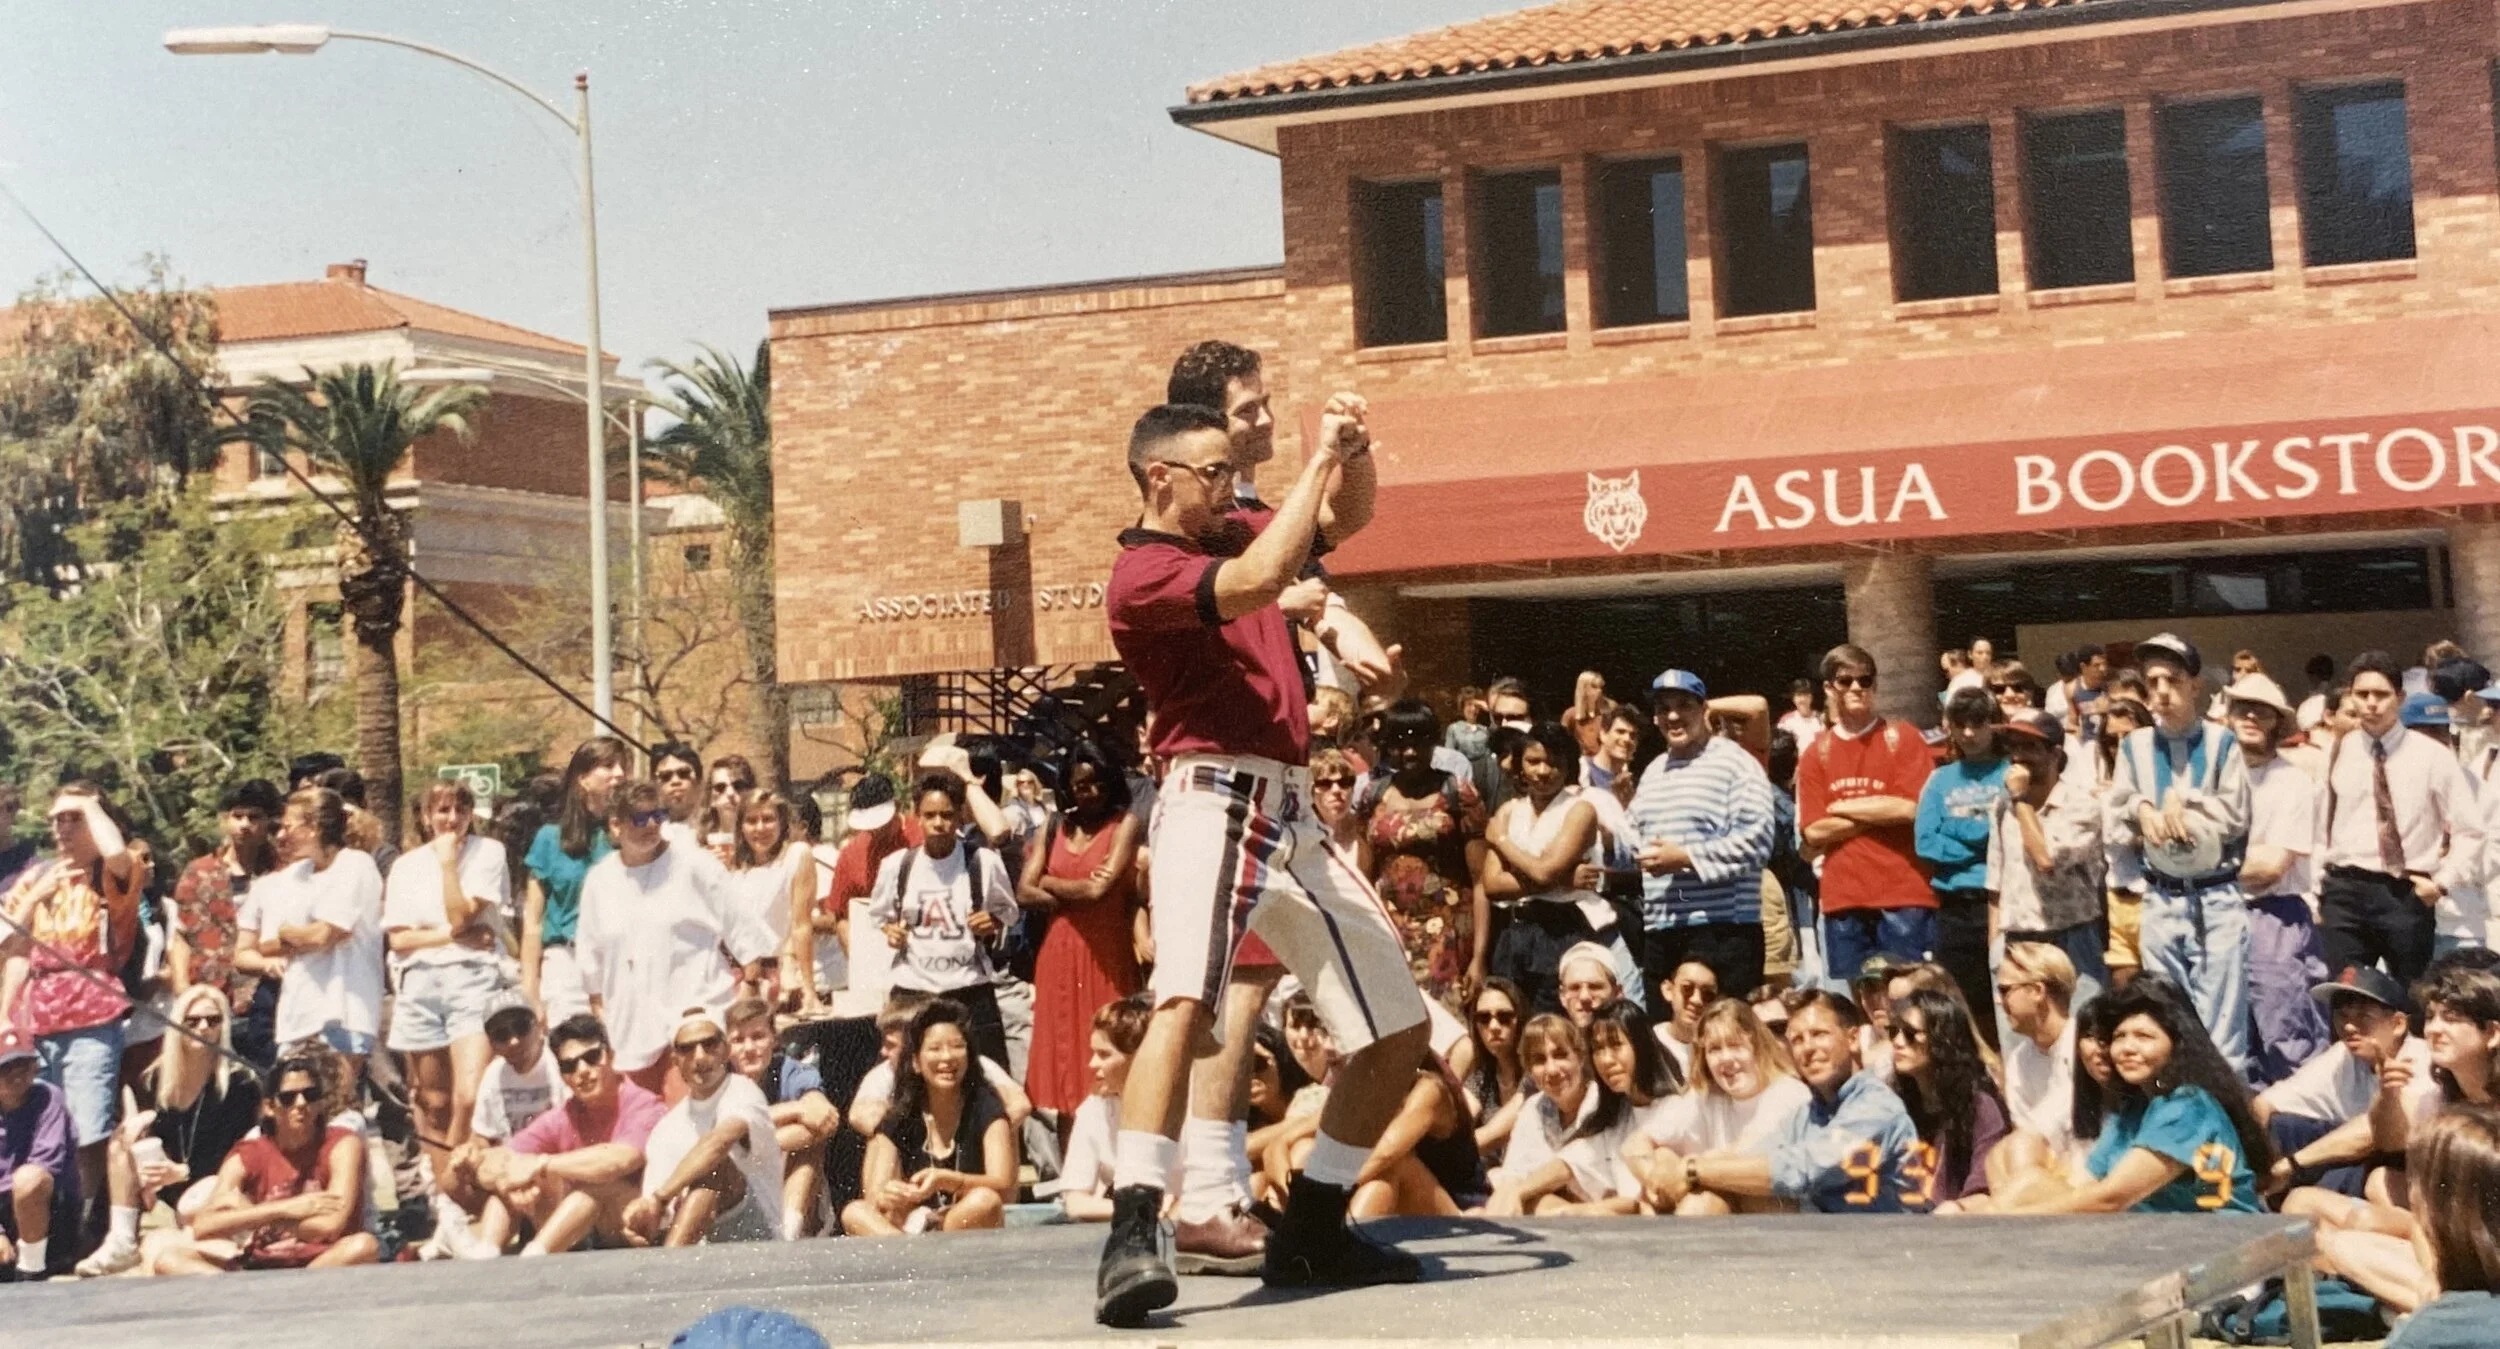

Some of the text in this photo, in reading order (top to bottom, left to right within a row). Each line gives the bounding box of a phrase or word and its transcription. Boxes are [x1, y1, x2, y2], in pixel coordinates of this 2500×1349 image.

[1712, 425, 2500, 533] ASUA BOOKSTOR
[858, 583, 1109, 624] ASSOCIATED STUD
[912, 889, 965, 940] A
